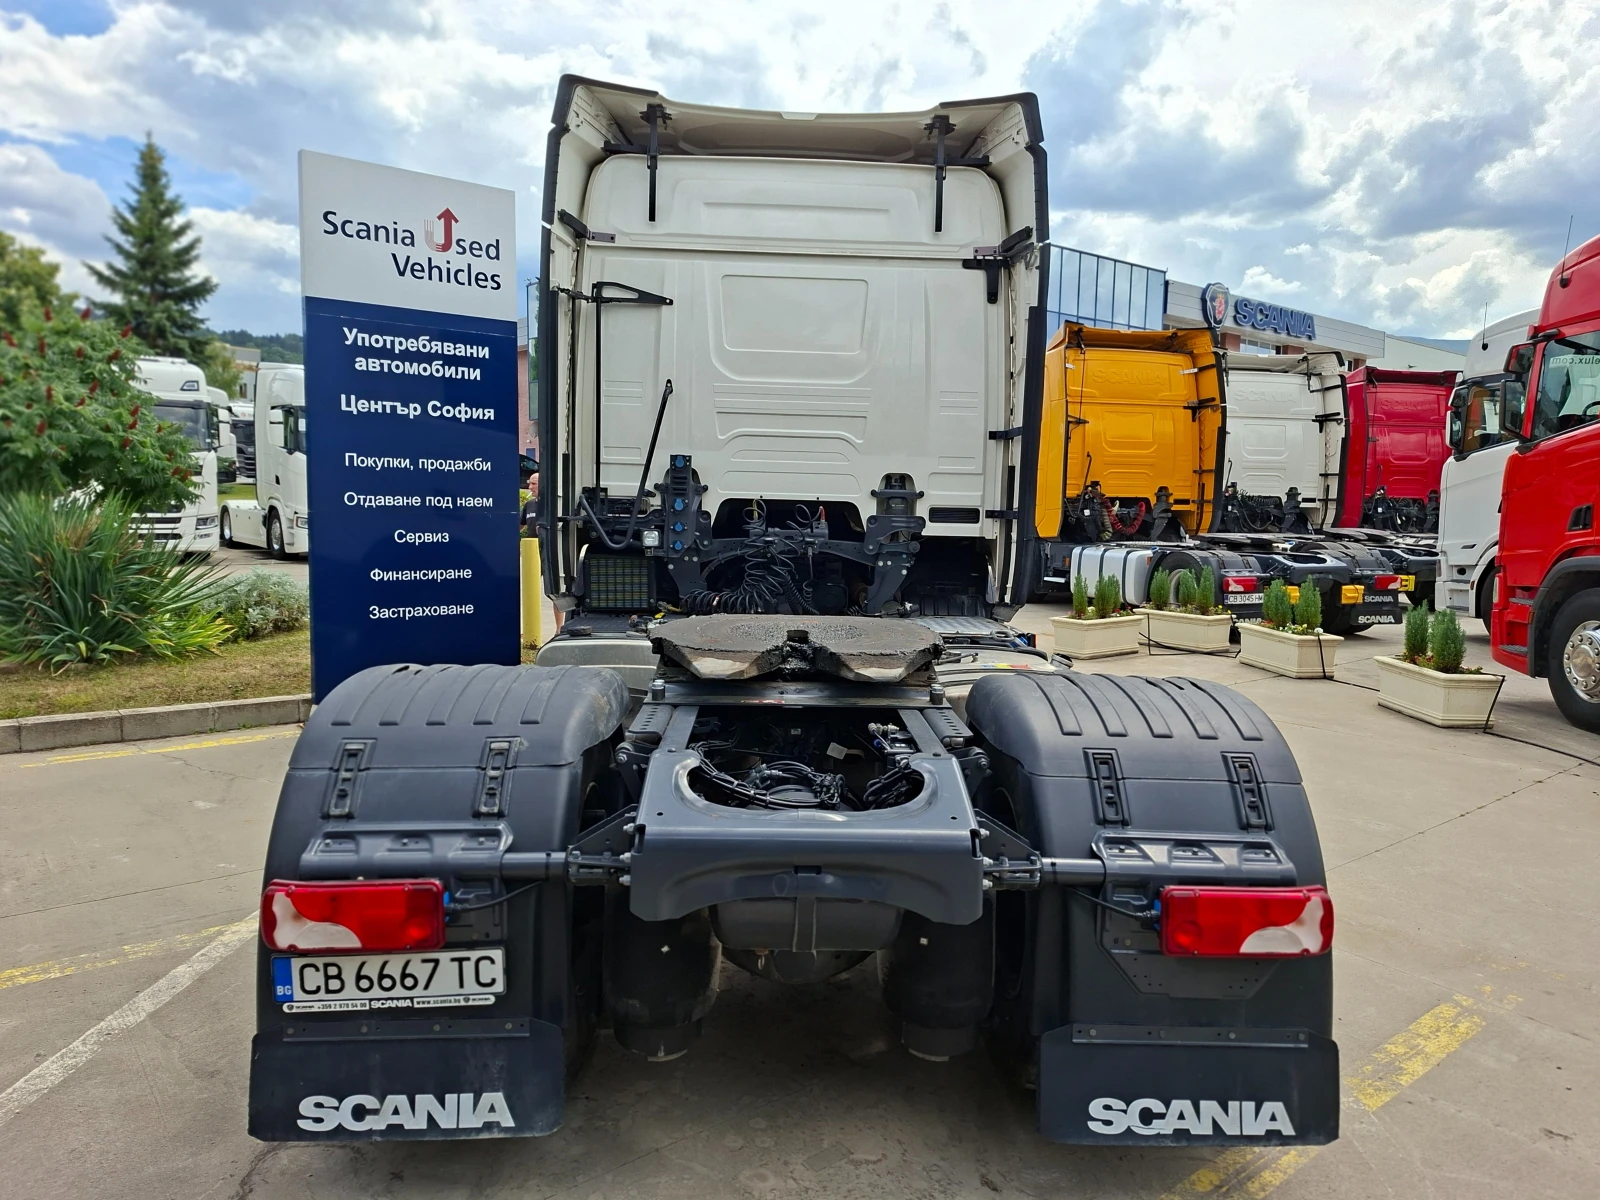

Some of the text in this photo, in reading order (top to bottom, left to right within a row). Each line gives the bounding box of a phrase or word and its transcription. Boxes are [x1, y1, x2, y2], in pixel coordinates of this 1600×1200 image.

[322, 210, 416, 248] Scania
[391, 253, 502, 291] Vehicles
[1234, 298, 1317, 341] SCANIA
[342, 327, 490, 359] Употребявани
[354, 356, 481, 381] автомобили
[1092, 368, 1165, 386] SCANIA
[1233, 388, 1297, 404] SCANIA
[340, 394, 495, 422] Център София
[345, 453, 492, 472] Покупки, продажби
[344, 492, 493, 509] Отдаване под наем
[394, 529, 450, 545] Сервиз
[370, 567, 472, 582] Финансиране
[369, 603, 474, 620] Застраховане
[1358, 615, 1395, 624] SCANIA
[299, 955, 497, 995] CB 6667 TC
[276, 985, 292, 996] BG
[370, 999, 412, 1009] SCANIA
[415, 998, 461, 1006] www.scania.bg
[296, 1092, 515, 1132] SCANIA
[1087, 1097, 1296, 1136] SCANIA
